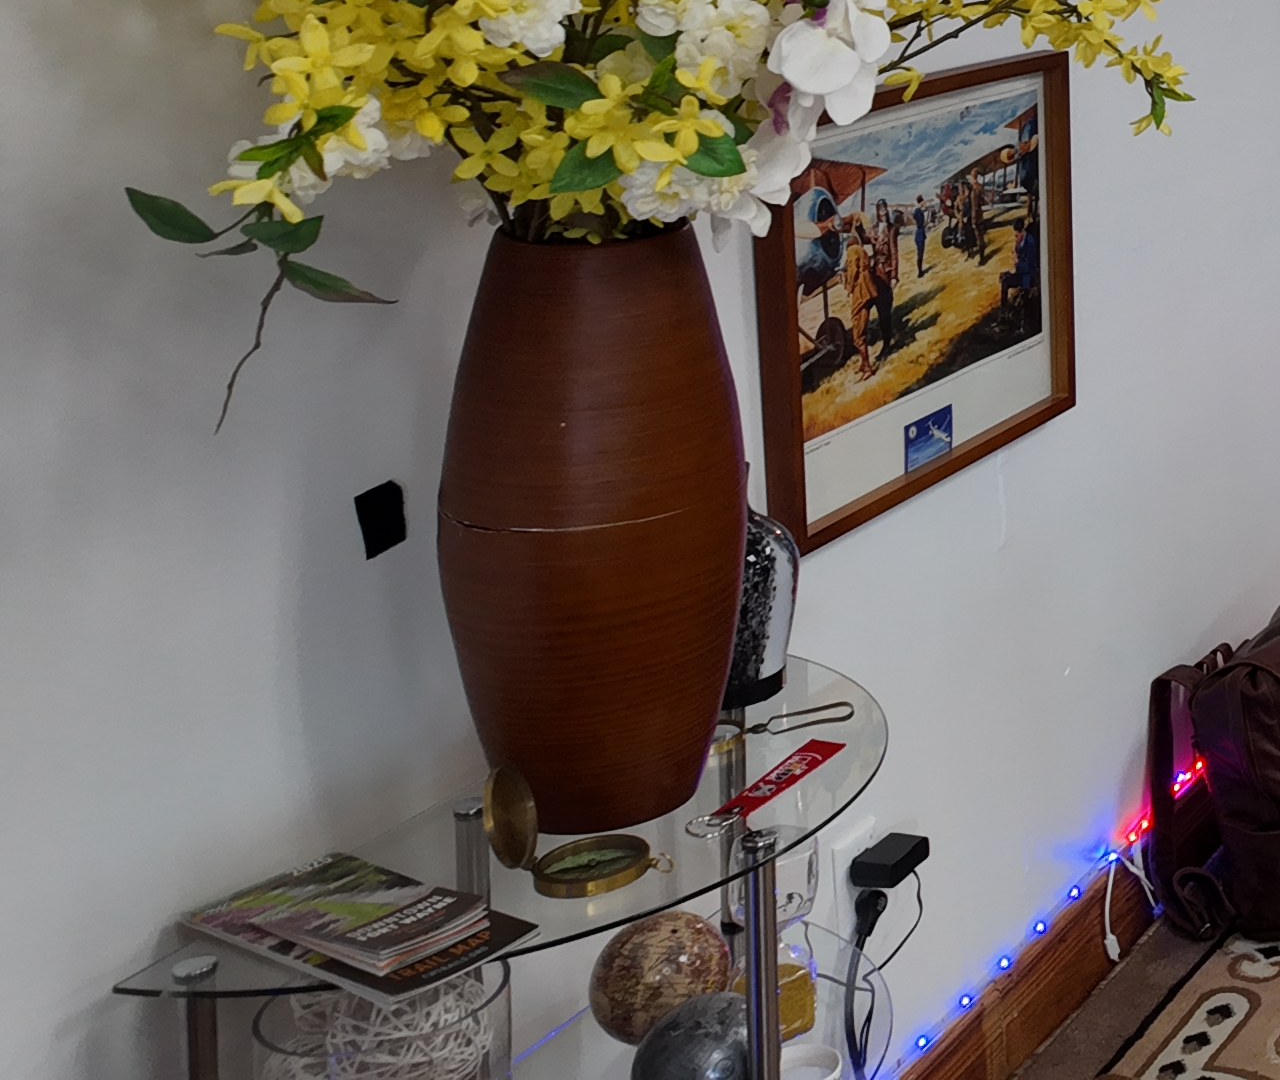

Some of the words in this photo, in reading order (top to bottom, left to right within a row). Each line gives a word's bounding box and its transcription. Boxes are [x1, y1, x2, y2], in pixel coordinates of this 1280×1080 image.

[347, 894, 444, 938] DOWNTOWN
[358, 923, 399, 942] FORT
[398, 896, 458, 924] WAYNE
[388, 956, 451, 981] TRAIL
[449, 929, 491, 955] MAP
